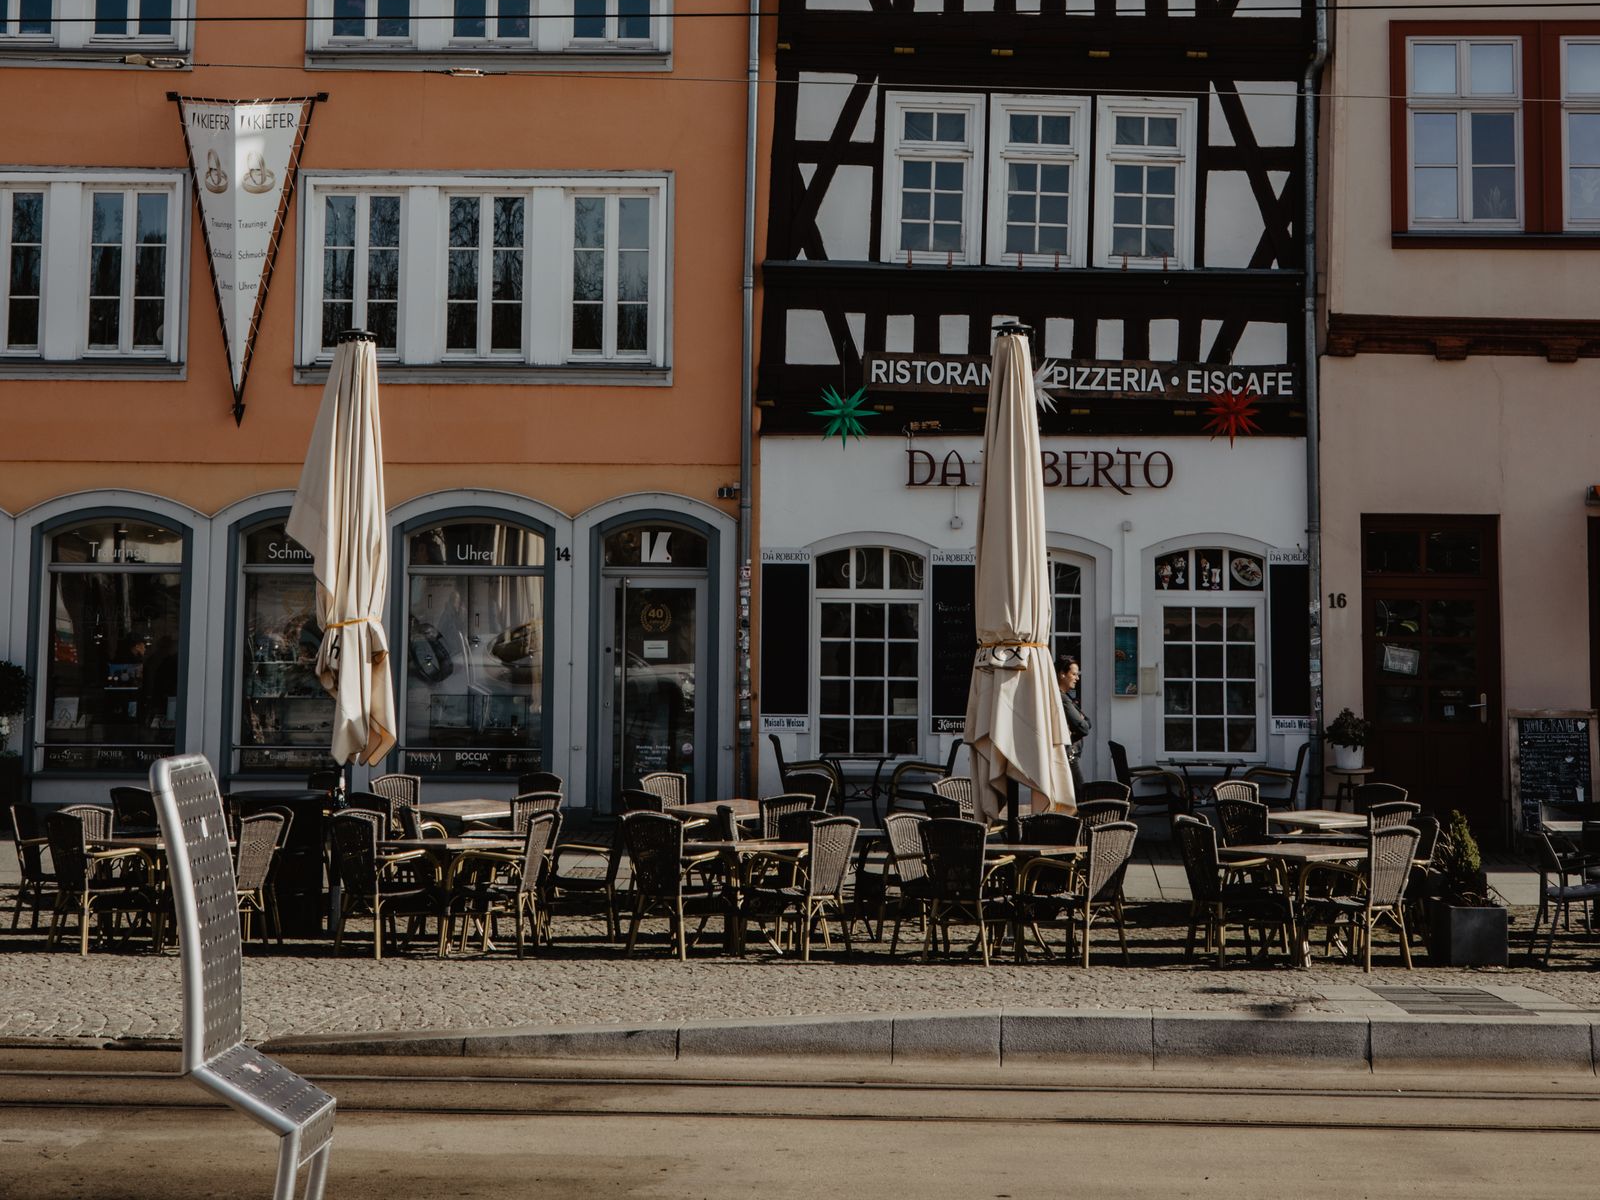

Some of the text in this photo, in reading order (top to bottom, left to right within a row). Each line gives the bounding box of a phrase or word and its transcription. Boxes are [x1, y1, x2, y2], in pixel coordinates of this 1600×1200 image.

[201, 113, 230, 130] KIEFER
[253, 112, 294, 130] KIEFER
[211, 217, 232, 230] Trauringe
[238, 219, 268, 230] Trauringe
[213, 248, 232, 260] Schmuck
[238, 249, 265, 260] Schmuck
[238, 280, 257, 291] Uhren
[871, 359, 1293, 395] RISTORAN PIZZERIA EISCAFE
[905, 447, 1173, 495] DA BERTO
[268, 542, 312, 559] Schmu
[556, 547, 570, 561] 14
[762, 552, 810, 561] DA ROBERTO
[1270, 552, 1308, 562] DA ROBER
[1328, 593, 1347, 608] 16
[648, 608, 664, 619] 40
[786, 718, 804, 727] Weisse
[937, 719, 965, 731] Köstrit
[1298, 720, 1311, 729] Weis
[455, 752, 488, 760] BOCCIA
